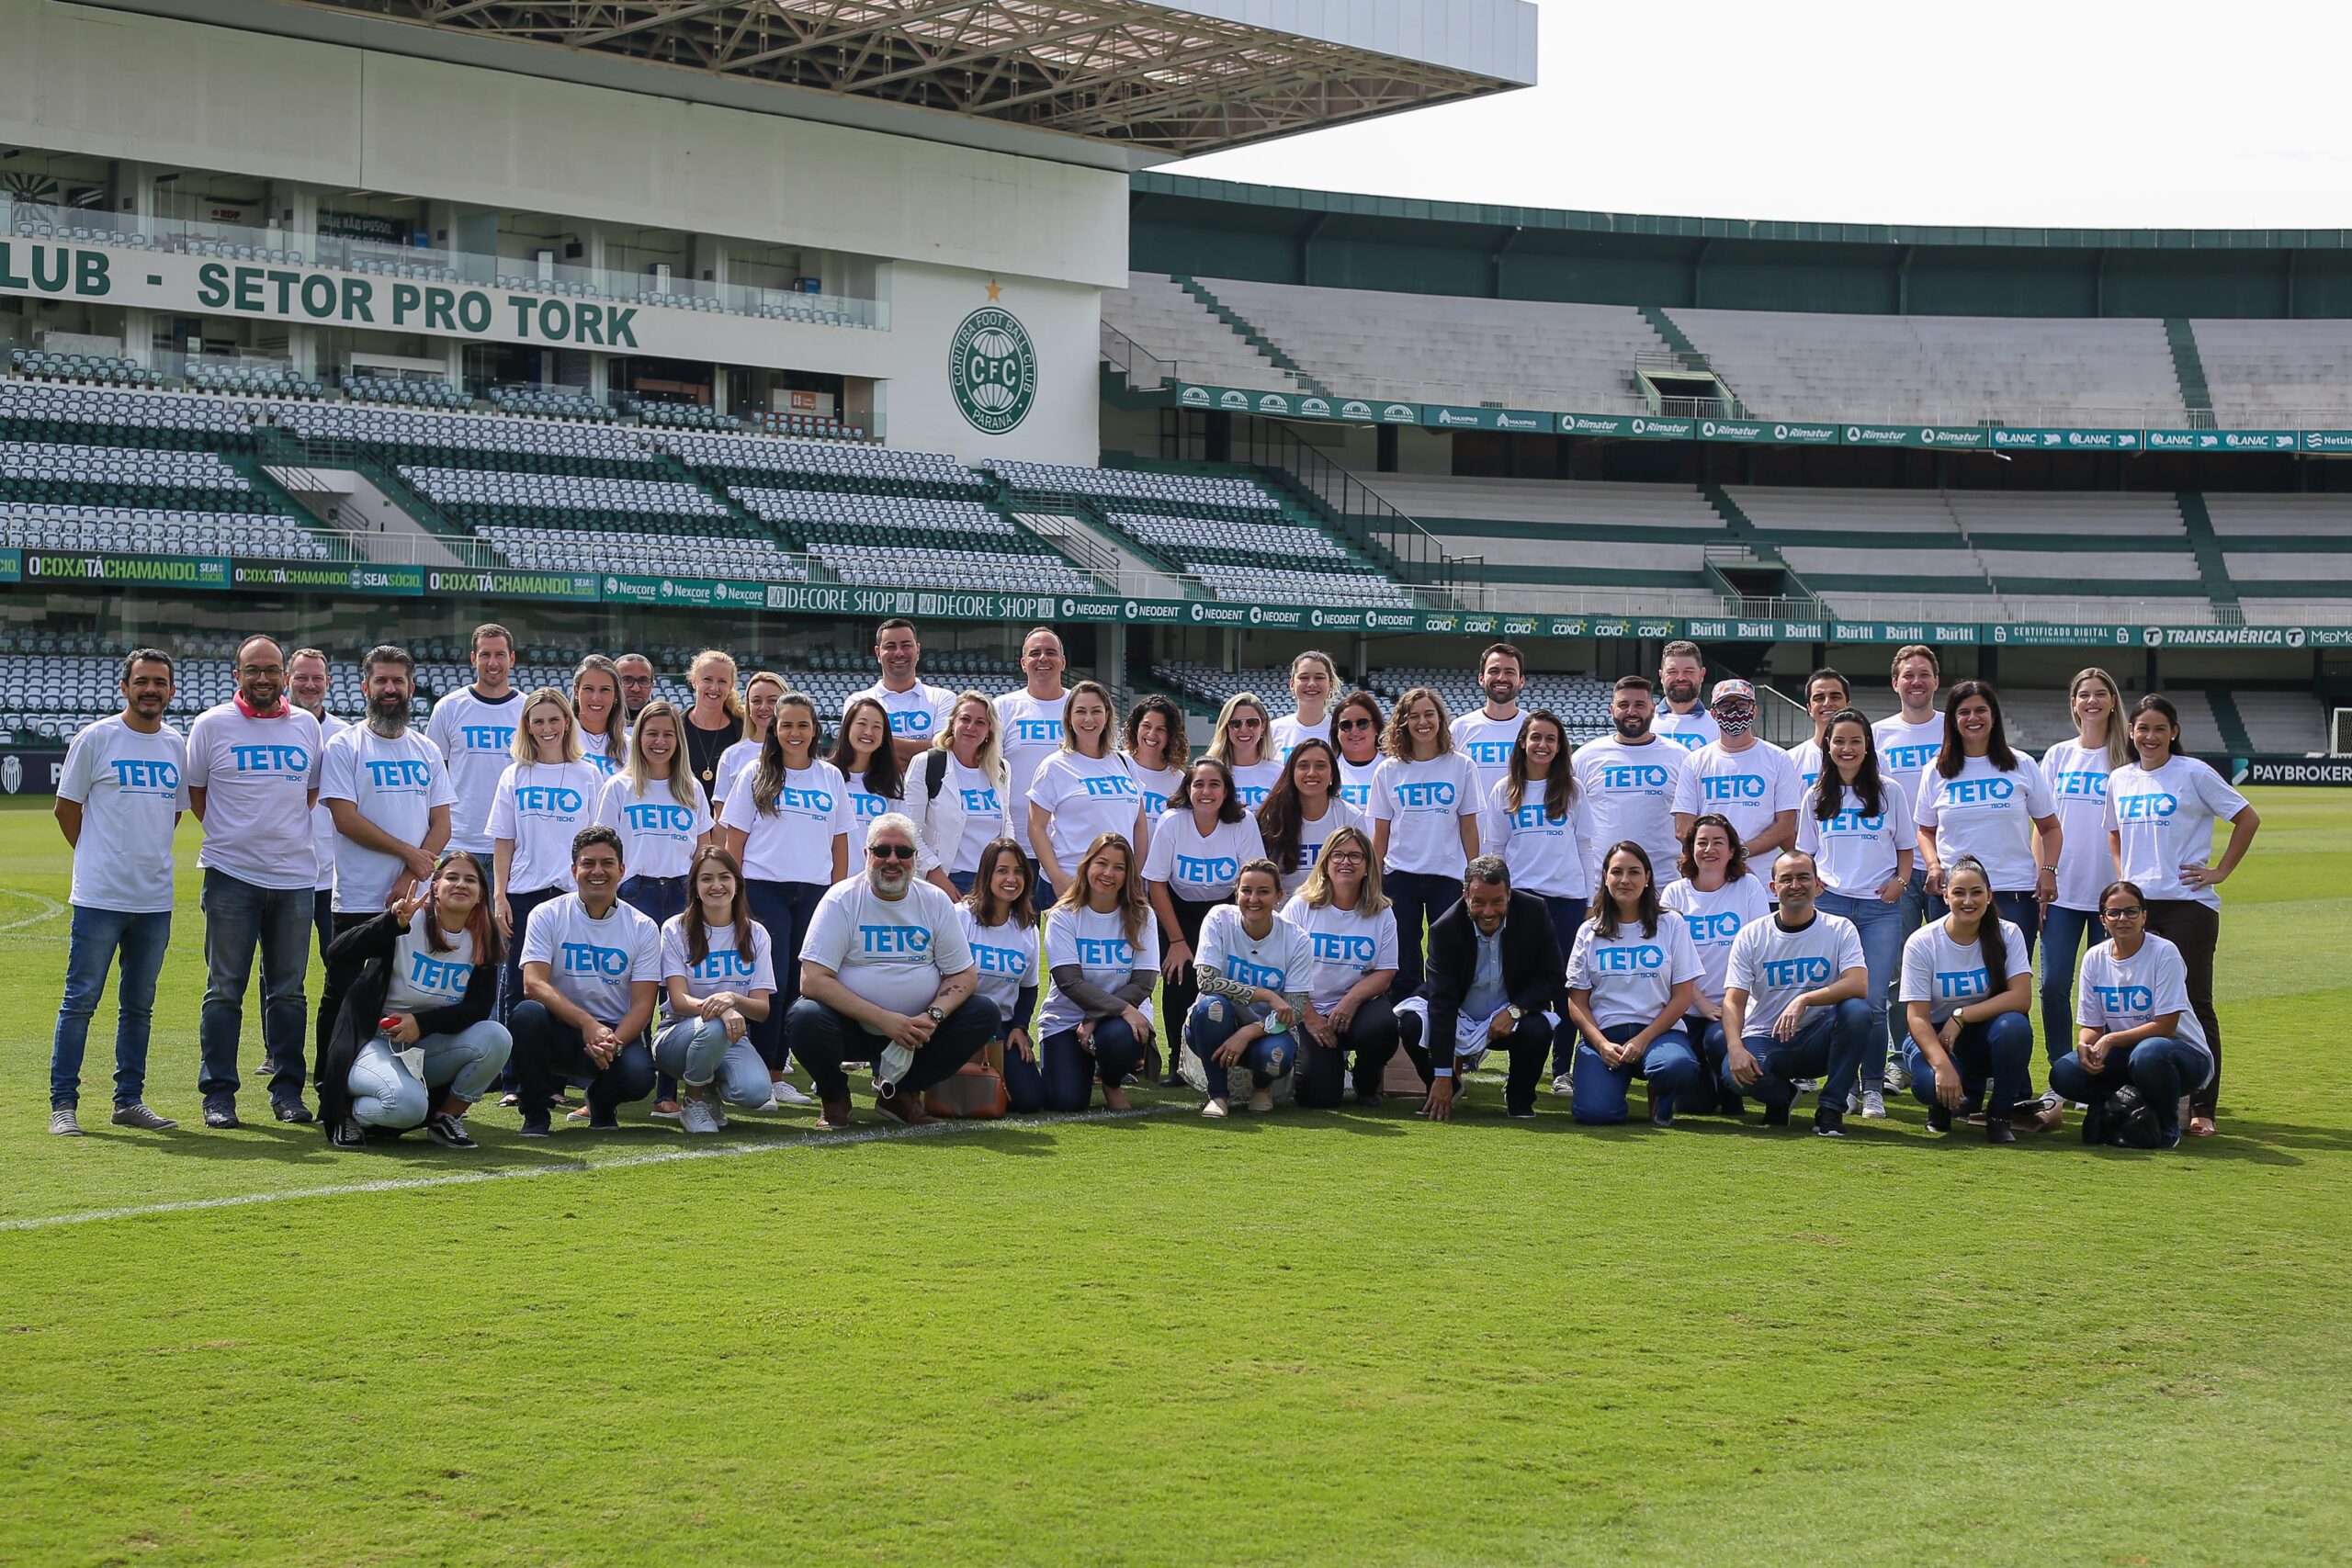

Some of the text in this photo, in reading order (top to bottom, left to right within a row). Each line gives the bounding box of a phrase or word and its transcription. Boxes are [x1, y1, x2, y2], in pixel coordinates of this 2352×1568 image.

[0, 242, 110, 296] LUB
[198, 263, 375, 322] SETOR
[392, 283, 492, 333] PRO
[508, 295, 639, 349] TORK
[953, 312, 1034, 394] CORITIBA FOOT BALL CLUB
[971, 355, 1016, 387] CFC
[1576, 419, 1618, 430] Rimatur
[1645, 423, 1689, 433] Rimatur
[1716, 425, 1760, 436] Rimatur
[1789, 428, 1833, 438] Rimatur
[1861, 430, 1906, 441] Rimatur
[1937, 432, 1982, 443] Rimatur
[619, 581, 655, 596] Nexcore
[674, 583, 710, 598] Nexcore
[729, 587, 763, 601] Nexcore
[790, 588, 895, 614] DECORE SHOP
[937, 594, 1037, 618] DECORE SHOP
[1077, 604, 1120, 615] NEODENT
[1138, 605, 1180, 618] NEODENT
[1204, 608, 1244, 620] NEODENT
[1261, 611, 1301, 624] NEODENT
[1323, 614, 1361, 625] NEODENT
[1377, 615, 1415, 626] NEODENT
[1426, 620, 1452, 631] coxa
[1464, 621, 1491, 632] coxa
[1504, 623, 1532, 634] coxa
[1553, 625, 1580, 635] coxa
[1595, 626, 1623, 636] coxa
[1638, 626, 1667, 637] coxa
[2014, 626, 2109, 637] CERTIFICADO DIGITAL
[2166, 627, 2281, 643] TRANSAMÉRICA
[230, 745, 308, 773] TETO
[1466, 741, 1512, 763] TET
[111, 760, 180, 789] TETO
[366, 760, 431, 787] TETO
[1601, 764, 1668, 787] TETO
[1078, 775, 1139, 796] TETO
[1394, 782, 1454, 807] TETO
[1702, 774, 1766, 800] TETO
[1946, 777, 2014, 805] TETO
[515, 786, 582, 813] TETO
[2118, 793, 2178, 819] TETO
[556, 815, 576, 823] TECHO
[623, 804, 694, 831] TETO
[670, 833, 688, 842] TECHO
[1177, 854, 1238, 883] TETO
[859, 925, 931, 953] TETO
[1309, 932, 1376, 962] TETO
[561, 942, 628, 976] TETO
[969, 942, 1026, 975] TETO
[1075, 938, 1135, 964] TETO
[1596, 944, 1664, 971] TETO
[412, 951, 474, 994] TETO
[1227, 953, 1285, 990] TETO
[1763, 956, 1831, 987] TETO
[1936, 967, 1990, 998] TET
[2093, 985, 2153, 1012] TETO
